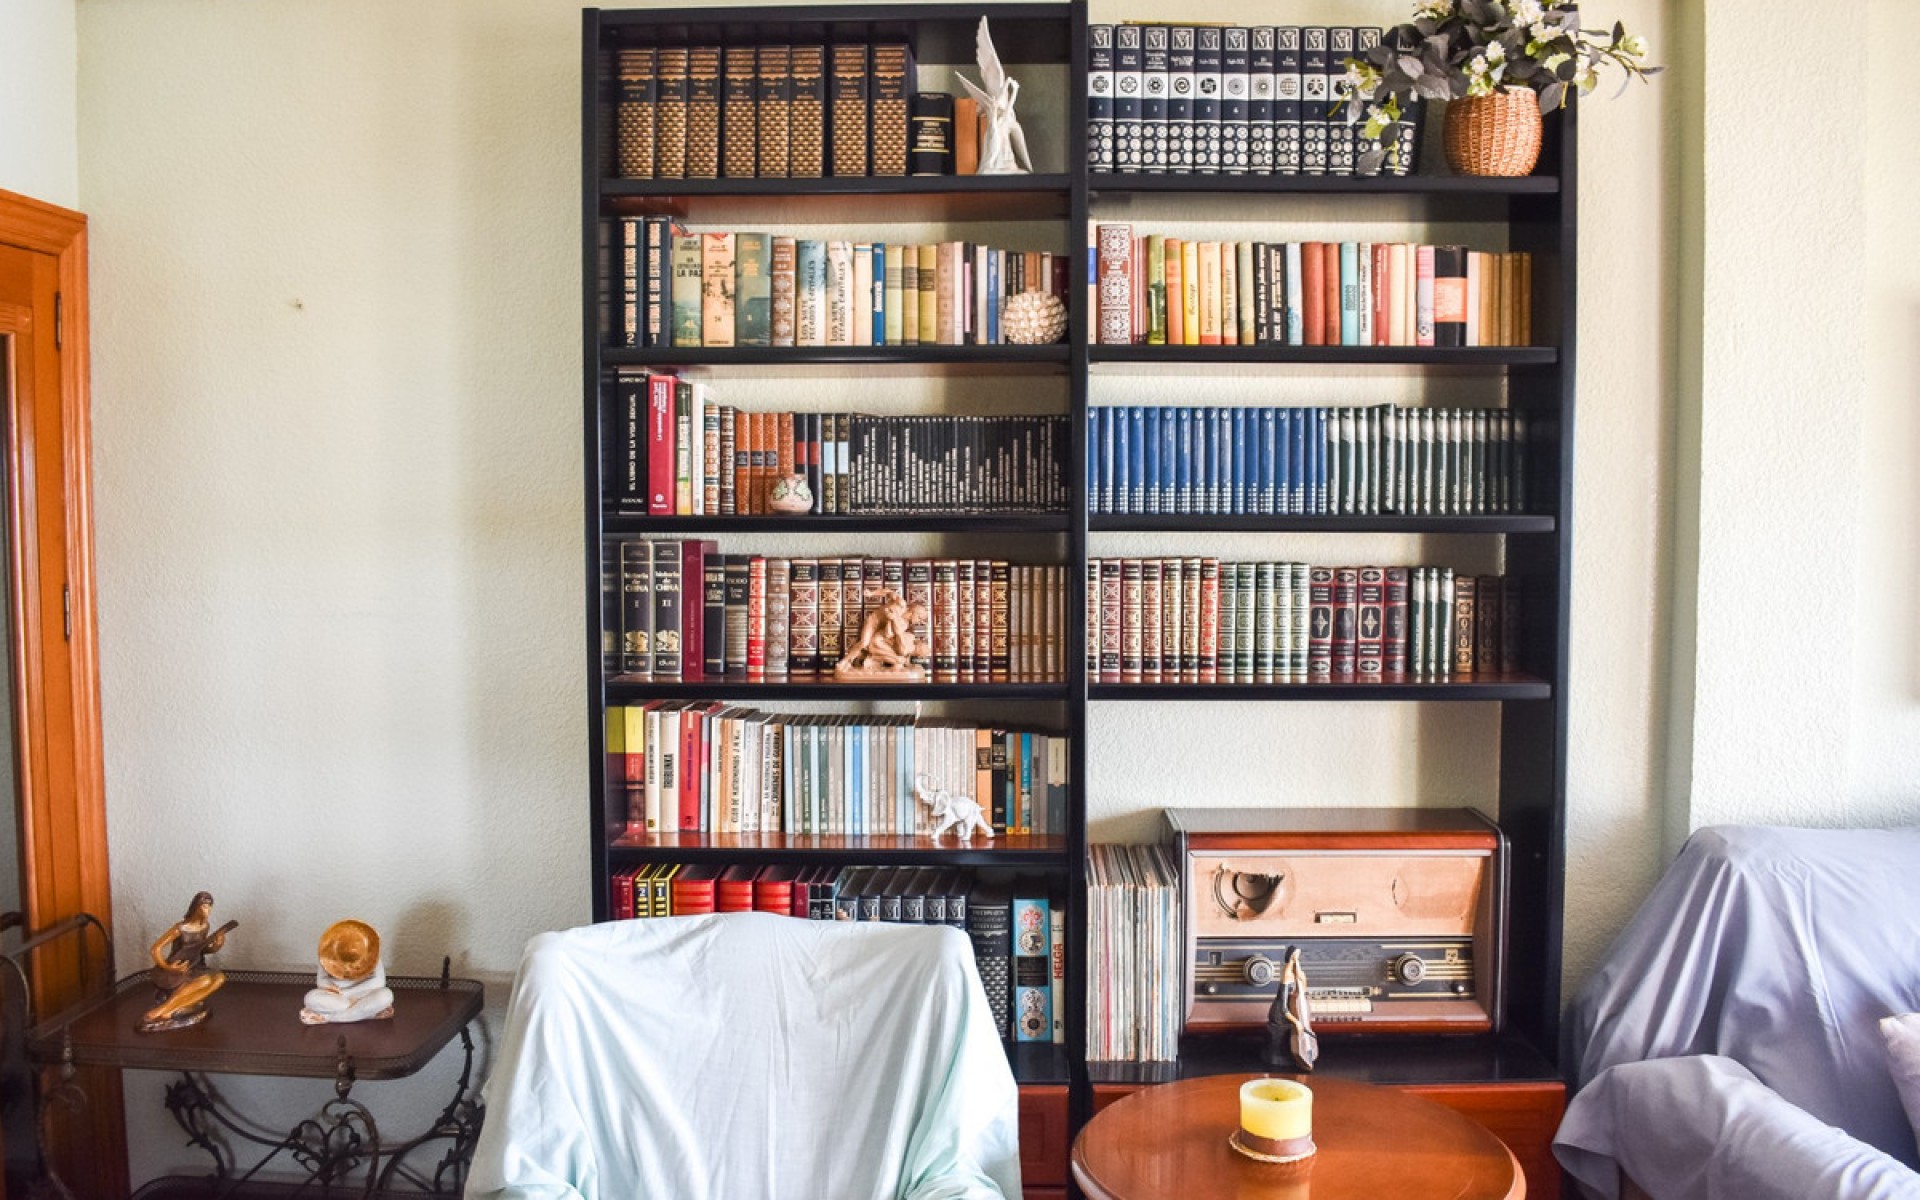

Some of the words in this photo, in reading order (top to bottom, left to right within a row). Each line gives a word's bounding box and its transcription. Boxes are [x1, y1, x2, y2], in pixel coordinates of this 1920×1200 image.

[626, 334, 635, 344] 2
[650, 334, 657, 344] 1
[656, 584, 679, 592] CHINA
[638, 888, 646, 896] 2
[657, 888, 662, 896] 1
[1054, 944, 1063, 979] HELGA
